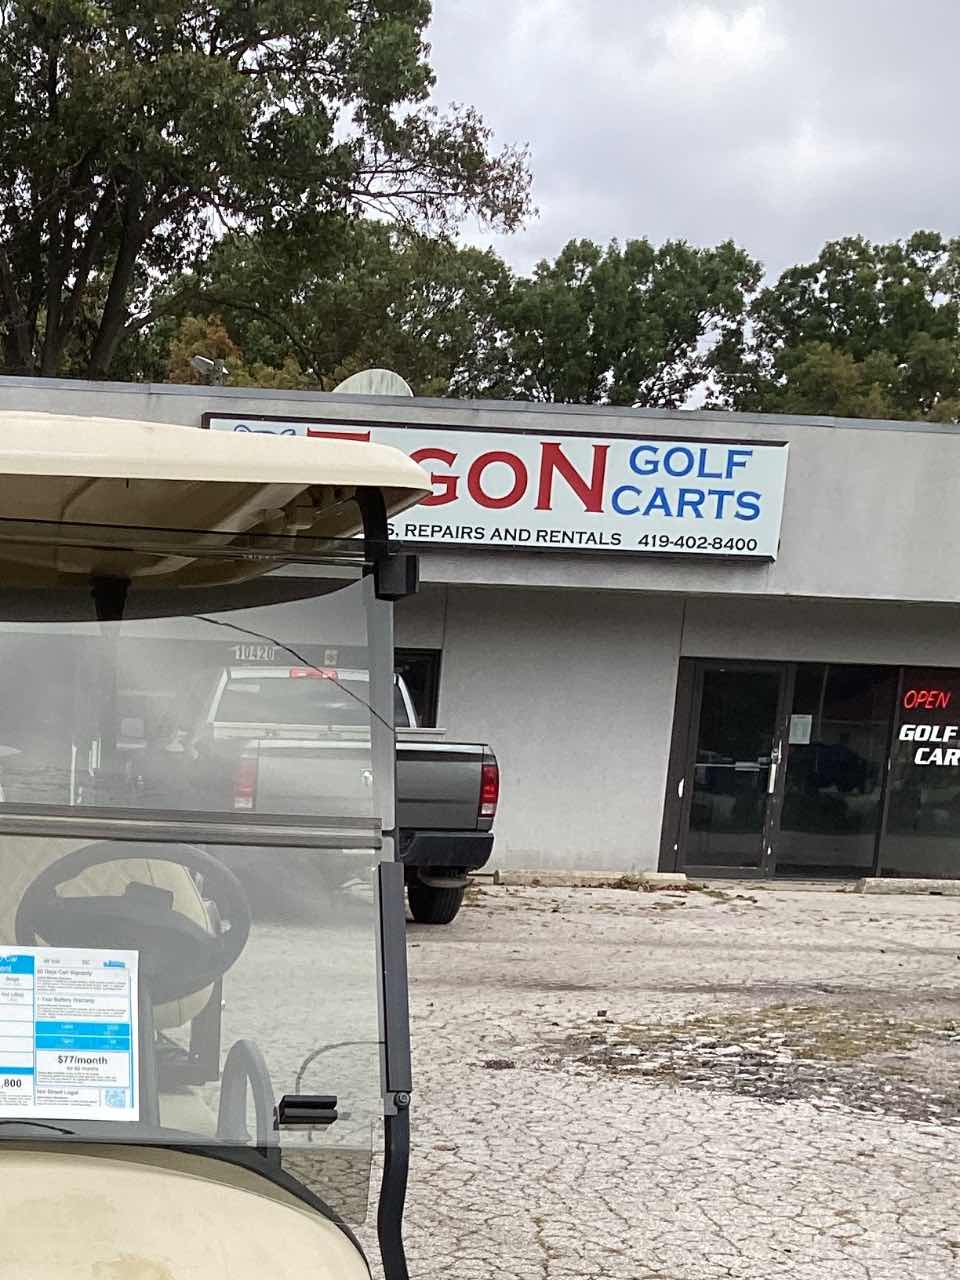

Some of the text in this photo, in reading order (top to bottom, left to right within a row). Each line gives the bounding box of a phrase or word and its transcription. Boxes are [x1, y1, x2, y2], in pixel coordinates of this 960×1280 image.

[629, 445, 754, 480] GOLF
[611, 485, 763, 521] CARTS
[405, 523, 485, 540] REPAIRS
[490, 528, 531, 543] AND
[536, 529, 622, 546] RENTALS
[638, 534, 758, 551] 419-402-8400
[904, 690, 951, 709] OPEN
[898, 724, 958, 742] GOLF
[914, 747, 960, 766] CAR
[58, 1055, 108, 1065] $77/month
